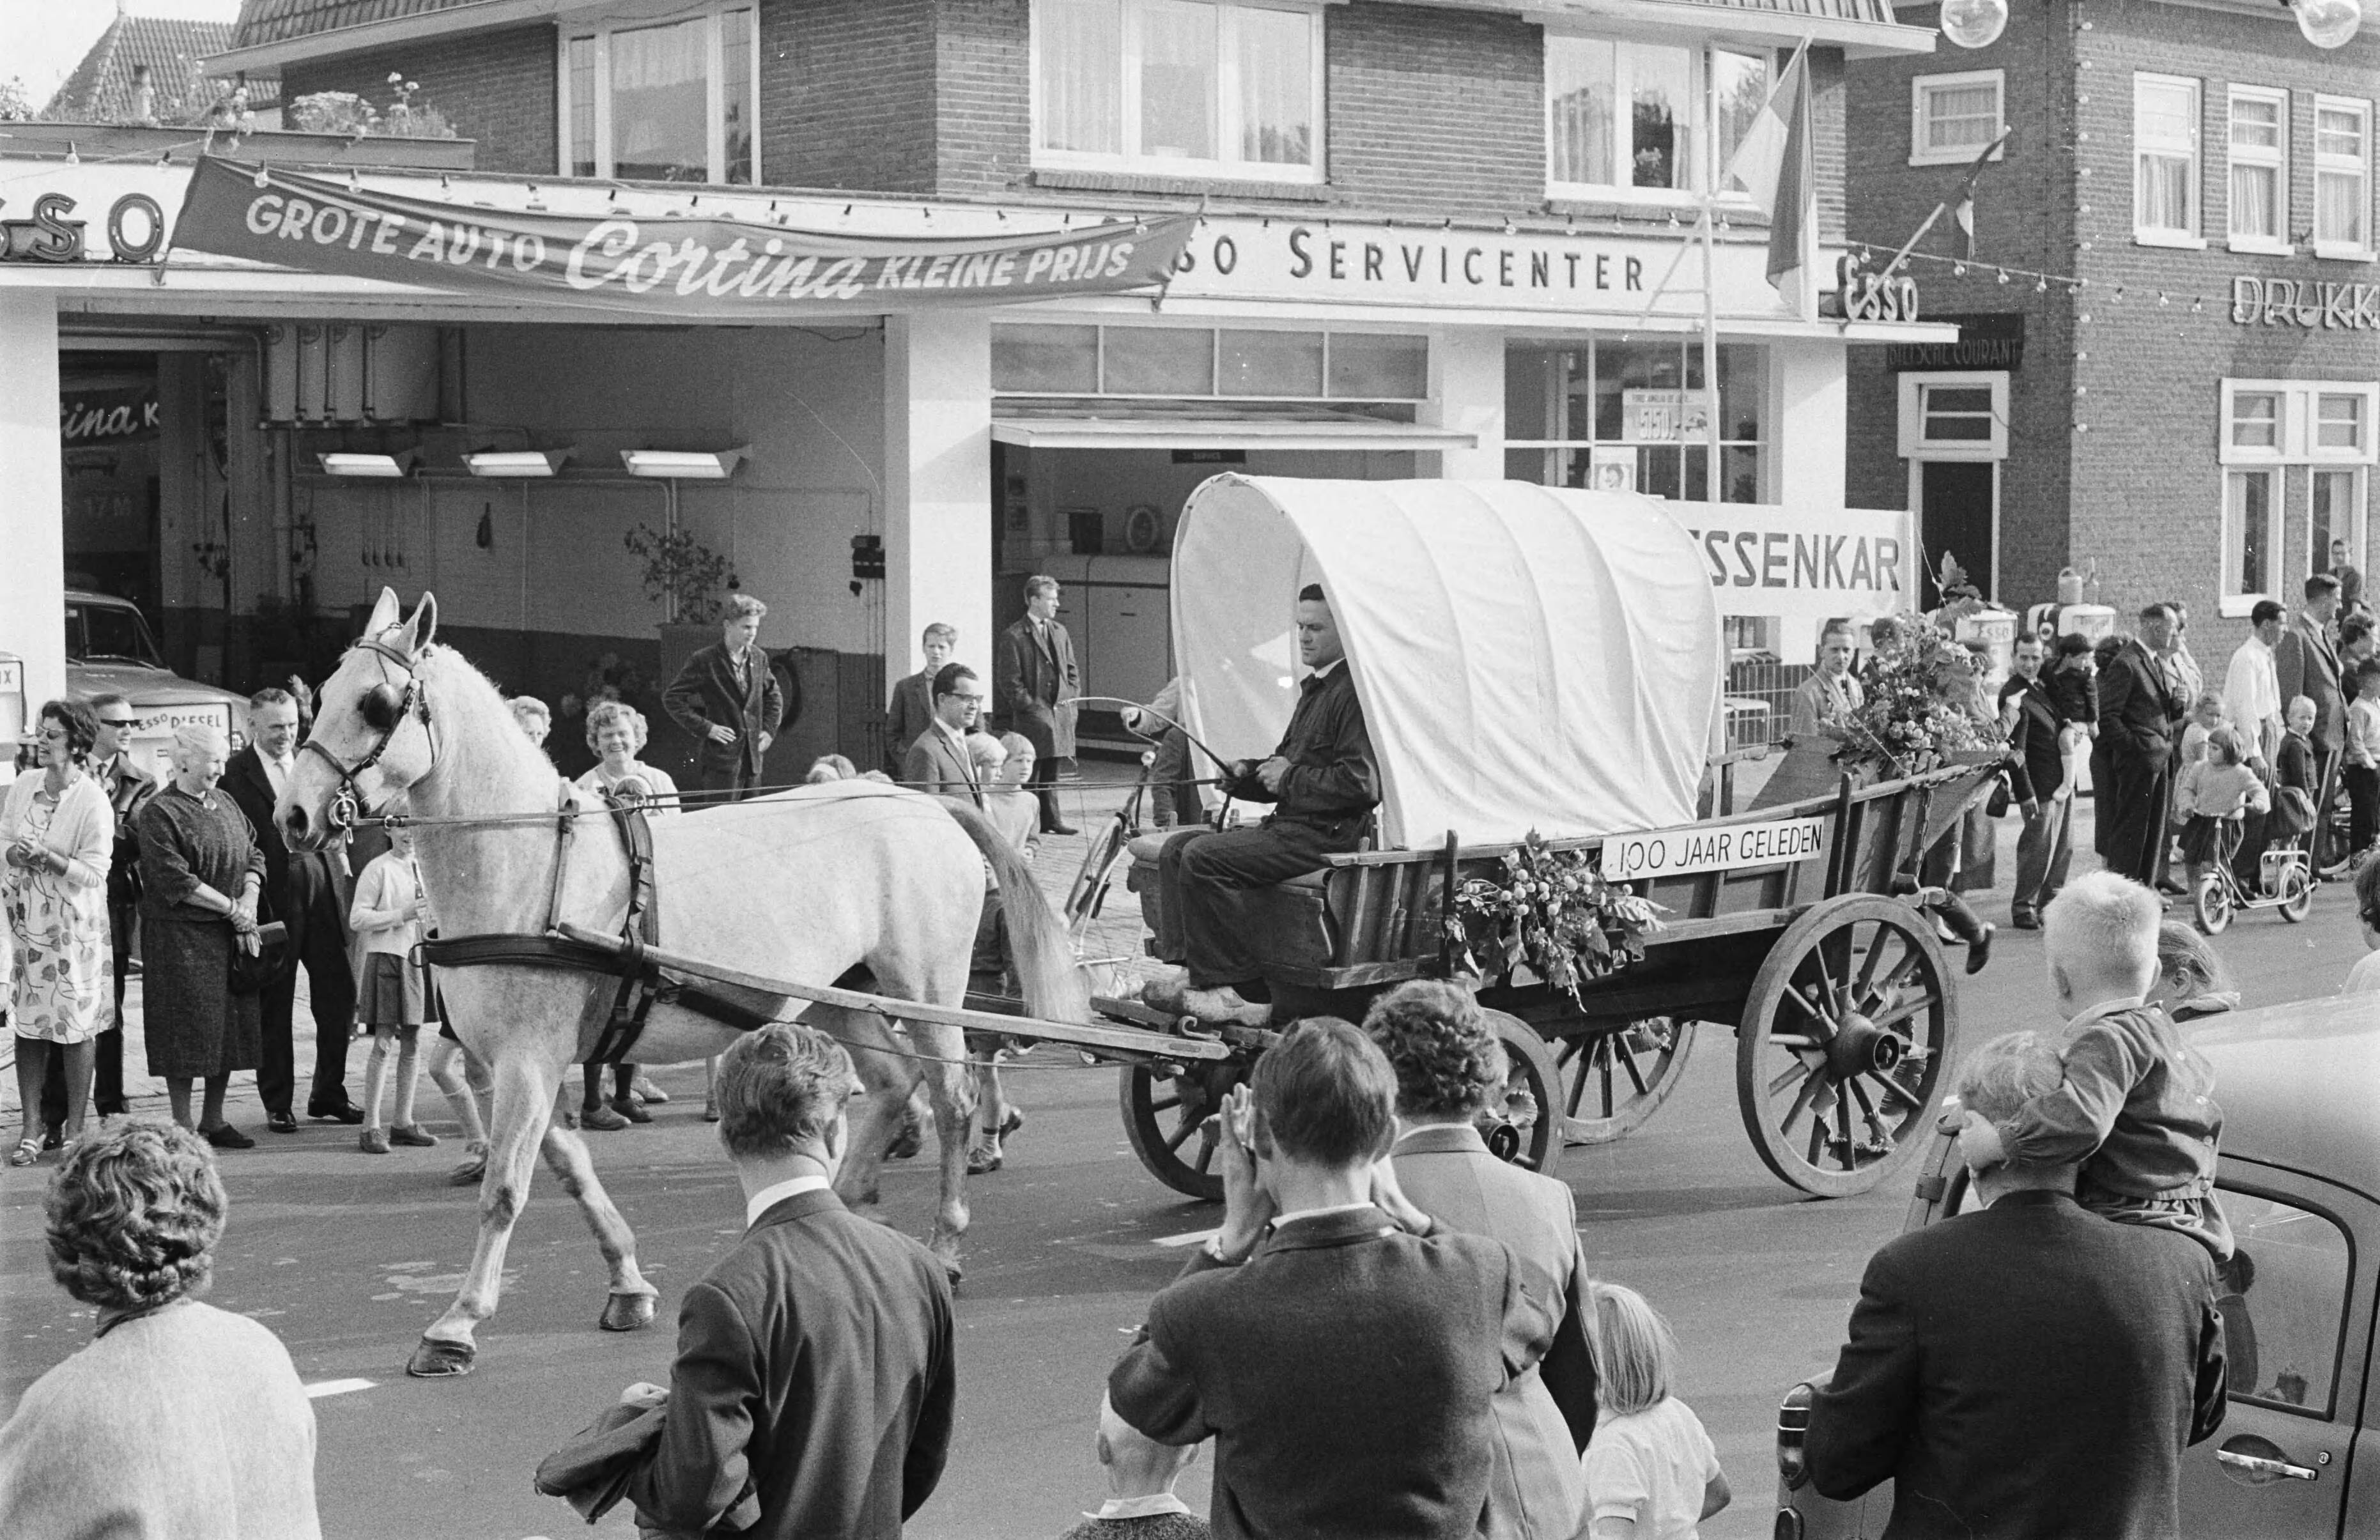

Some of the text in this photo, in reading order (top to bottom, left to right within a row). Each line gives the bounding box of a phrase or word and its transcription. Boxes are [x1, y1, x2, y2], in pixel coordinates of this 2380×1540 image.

[246, 195, 1134, 300] GROTE AUTO Cortina KLEINE PRIJS
[1289, 226, 1643, 291] SERVICENTER
[1844, 254, 1918, 321] ESSO
[1953, 338, 2019, 366] COURANT
[139, 713, 168, 731] ESSO
[1619, 824, 1822, 873] 100 JAAR GELEDEN
